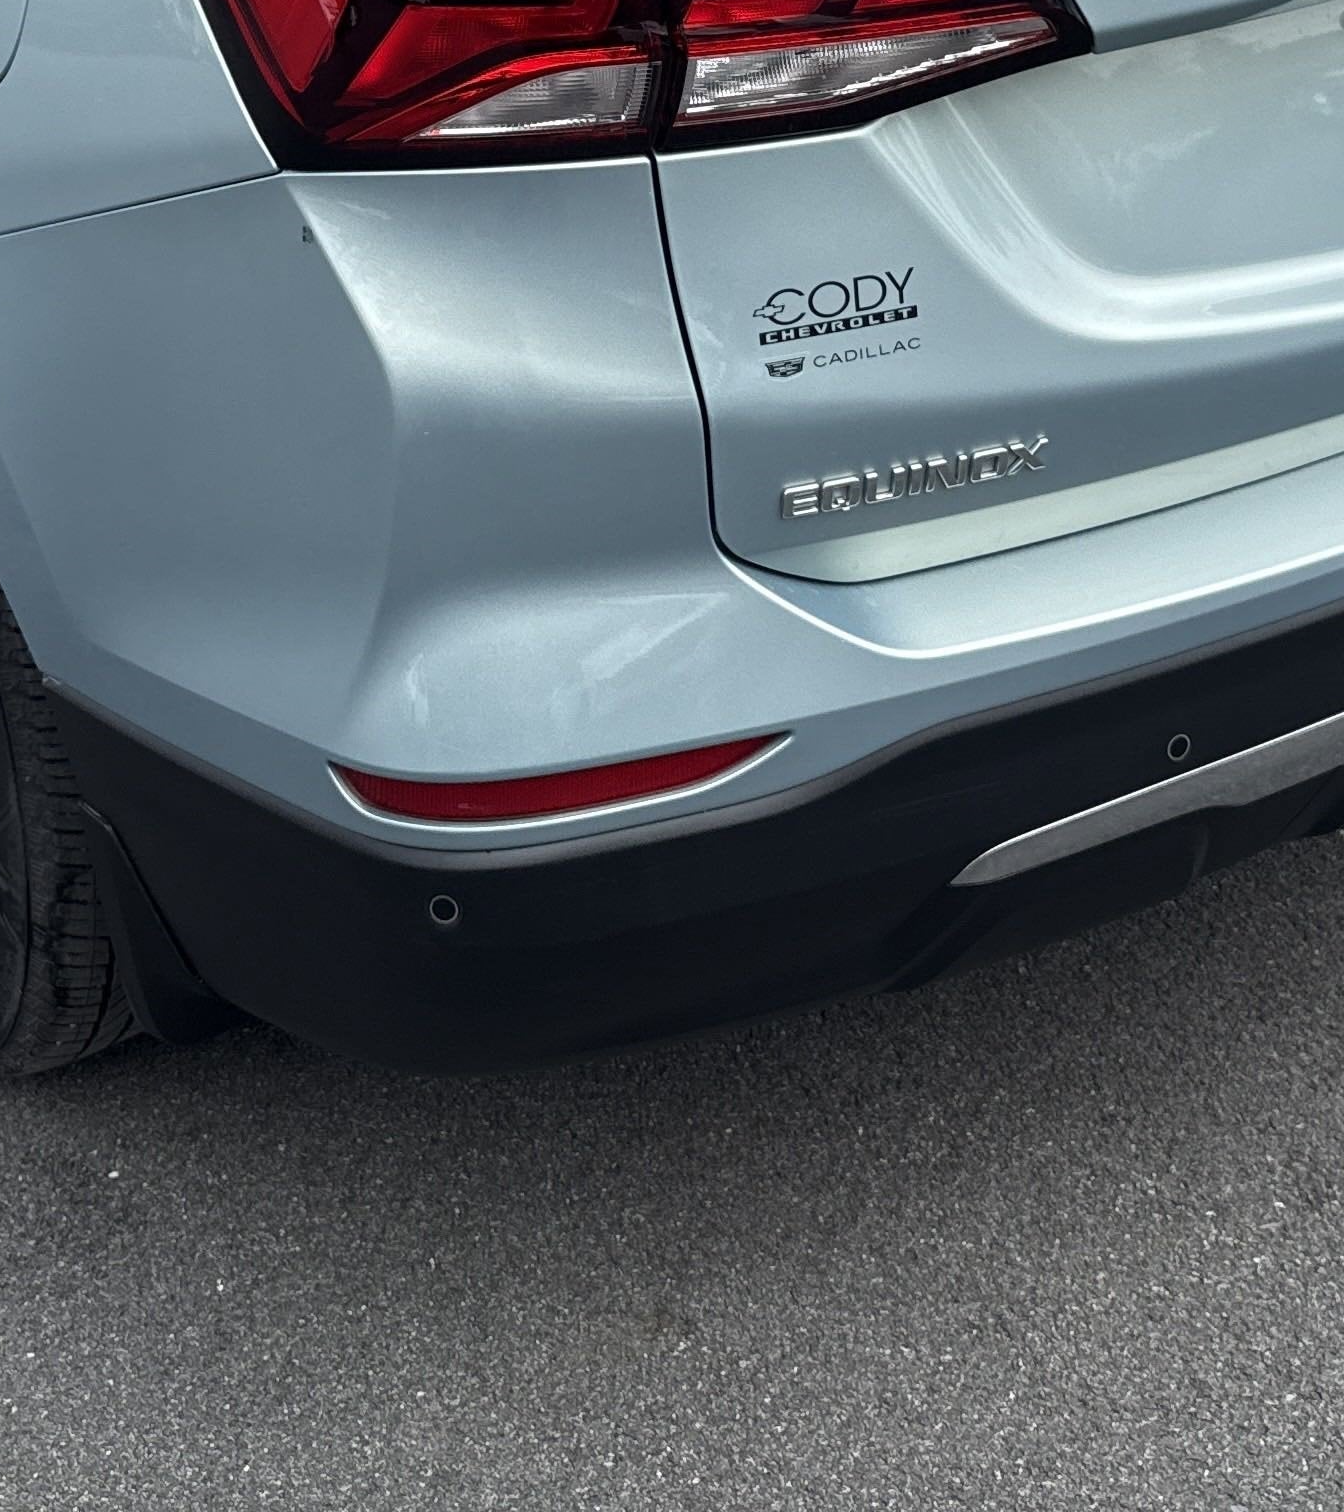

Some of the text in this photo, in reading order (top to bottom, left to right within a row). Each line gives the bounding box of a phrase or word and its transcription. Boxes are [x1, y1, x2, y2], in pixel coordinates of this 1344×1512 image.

[764, 266, 915, 325] CODY
[762, 306, 916, 345] CHEVROLET
[812, 336, 922, 368] CADILLAC
[782, 434, 1049, 519] EQUINOX
